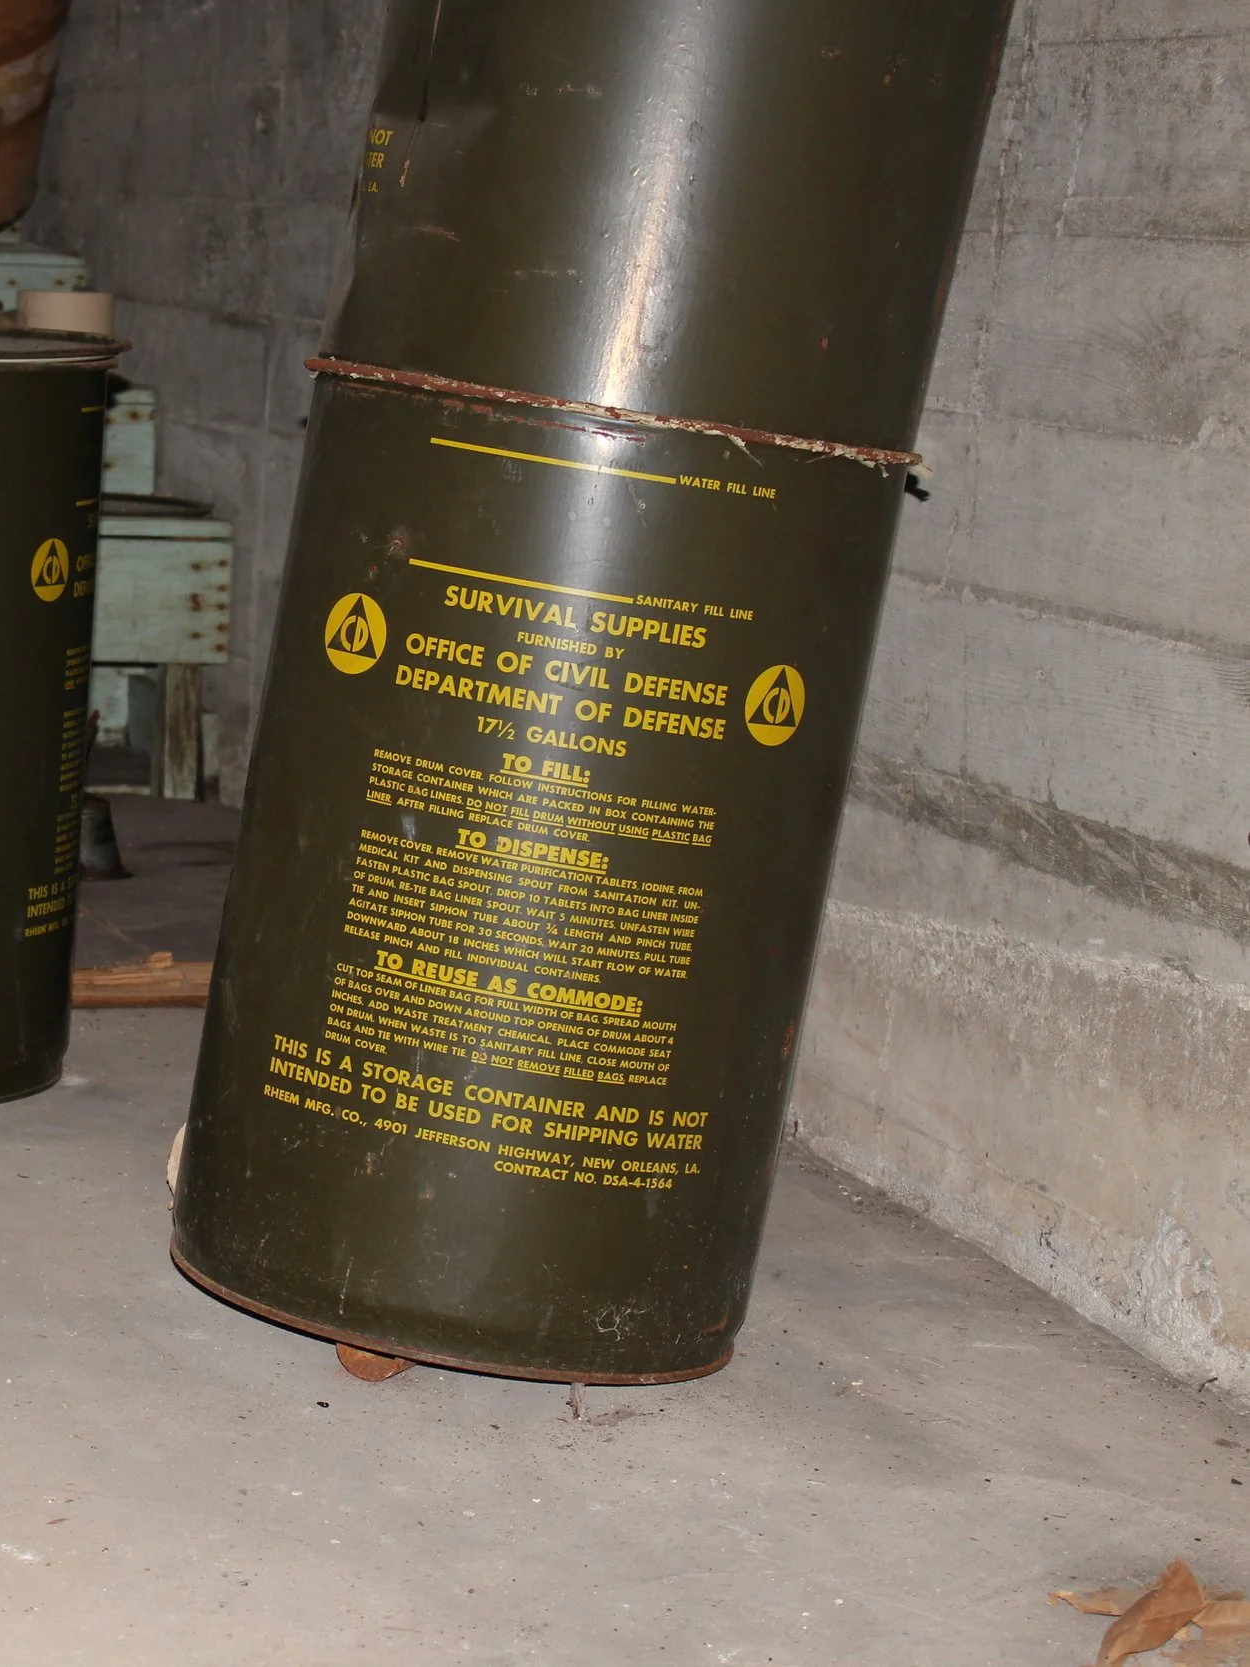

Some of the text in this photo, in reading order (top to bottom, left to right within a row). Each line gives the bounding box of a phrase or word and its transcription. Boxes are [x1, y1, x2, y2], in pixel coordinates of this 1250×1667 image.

[679, 474, 777, 499] WATER FILL LINE
[443, 584, 707, 648] SURVIVAL SUPPLIES
[635, 594, 754, 621] SANITARY FILL LINE
[405, 632, 729, 706] OFFICE OF CIVIL DEFENSE
[516, 631, 625, 660] FURNISHED BY
[395, 664, 726, 740] DEPARTMENT OF DEFENSE
[499, 752, 591, 784] TO FILL:
[526, 725, 627, 757] GALLONS
[371, 762, 715, 830] STORAGE CONTAINER WHICH ARE PACKED IN BOX CONTAINING THE
[454, 827, 609, 870] TO DISPENSE:
[27, 884, 48, 901] THIS
[373, 949, 643, 1015] TO REUSE AS COMMODE:
[367, 999, 390, 1012] ADD
[393, 1004, 429, 1022] WASTE
[431, 1013, 494, 1035] TREATMENT
[556, 1037, 590, 1050] PLACE
[592, 1042, 646, 1057] COMMODE
[648, 1048, 672, 1059] SEAT
[269, 1056, 703, 1150] INTENDED TO BE USED FOR SHIPPING WATER
[274, 1033, 709, 1128] THIS IS A STORAGE CONTAINER AND IS NOT
[263, 1084, 700, 1175] RHEEM MFG. CO., 4901 JEFFERSON HIGHWAY, NEW ORLEANS, LA.
[493, 1160, 673, 1189] CONTRACT NO. DSA-4-1564
